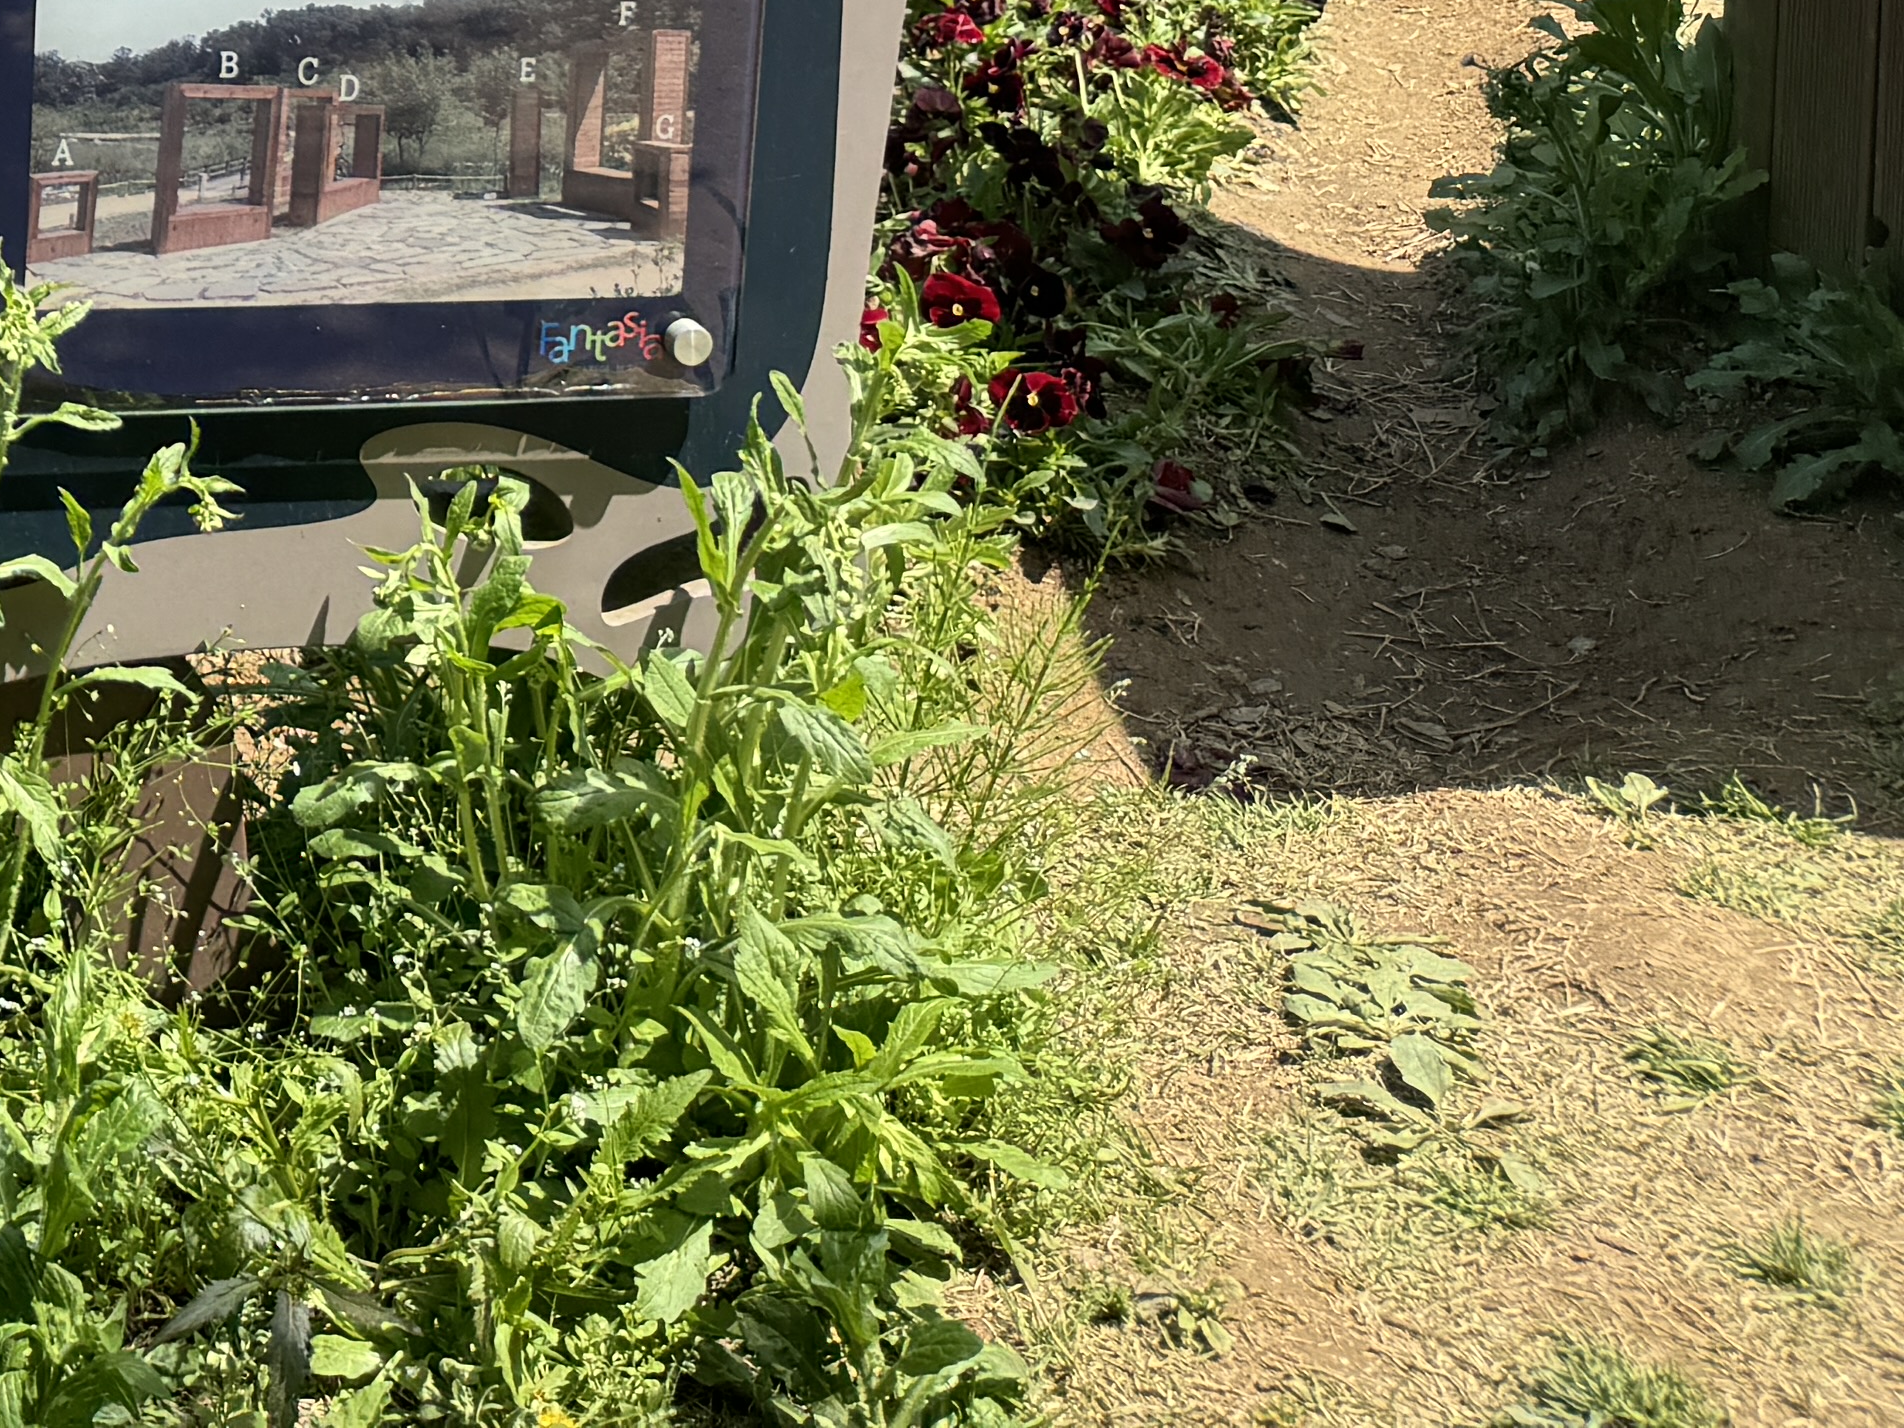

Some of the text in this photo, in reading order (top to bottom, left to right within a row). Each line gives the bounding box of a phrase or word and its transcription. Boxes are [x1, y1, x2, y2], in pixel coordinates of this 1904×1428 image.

[618, 1, 637, 28] F
[218, 50, 239, 79] B
[297, 56, 319, 86] C
[519, 57, 537, 83] E
[337, 74, 361, 102] D
[655, 115, 675, 140] G
[51, 139, 75, 167] A
[539, 311, 666, 365] Fantasia
